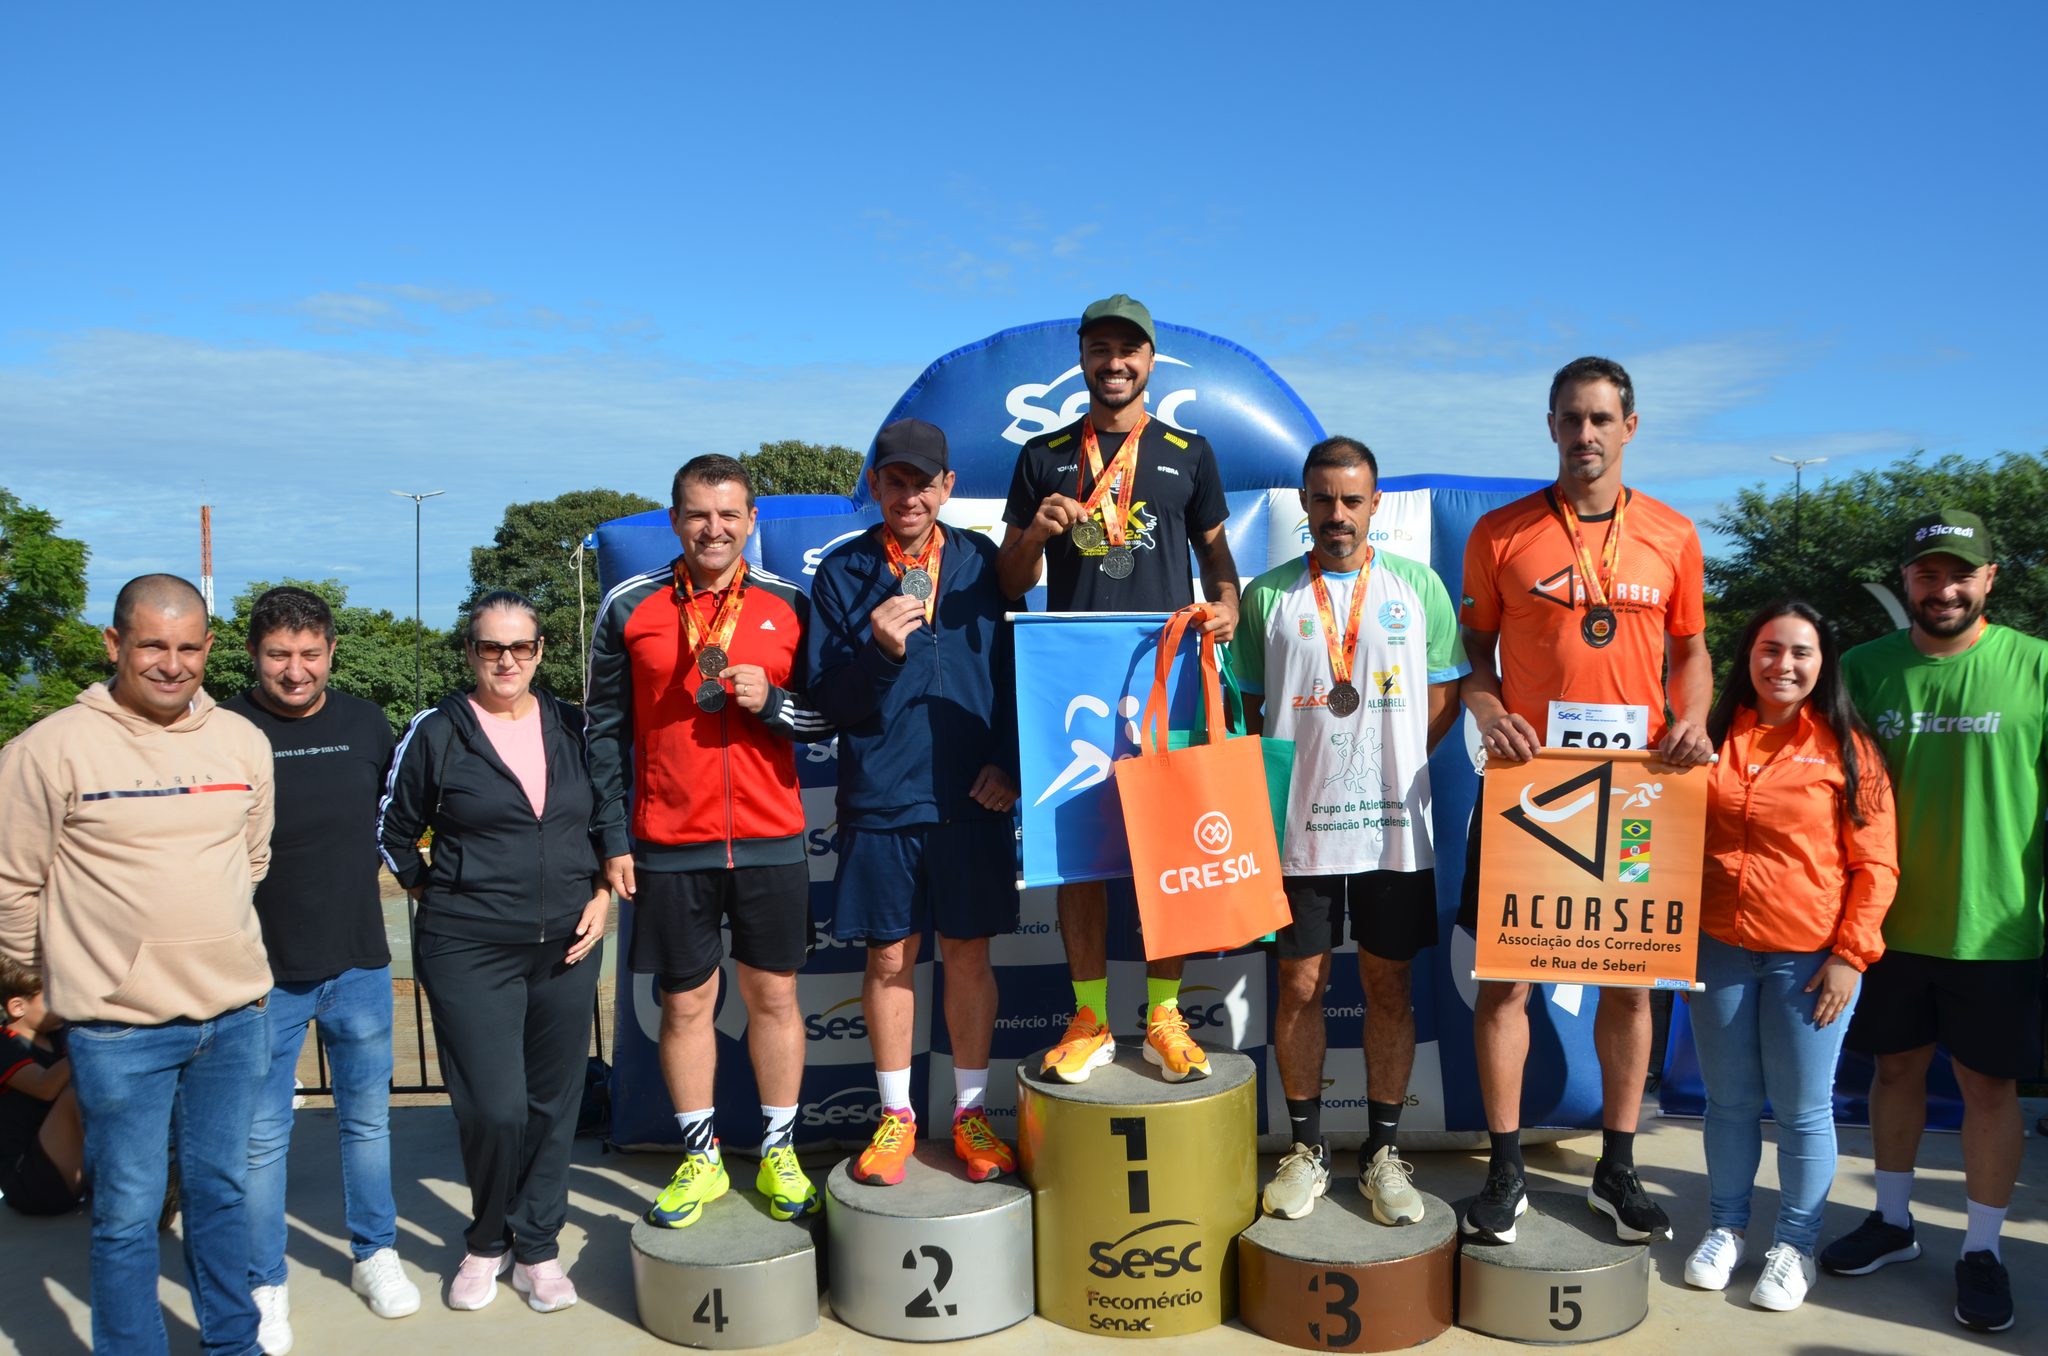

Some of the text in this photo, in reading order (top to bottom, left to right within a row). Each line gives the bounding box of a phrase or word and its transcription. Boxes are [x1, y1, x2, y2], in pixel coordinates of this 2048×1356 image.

[1001, 383, 1198, 446] Sec
[1928, 524, 1974, 538] Sicredi
[1575, 583, 1660, 605] ARSEB
[1909, 711, 2001, 734] Sicredi
[134, 774, 214, 788] PARIS
[1311, 799, 1403, 816] Grupo de Atletismo
[1305, 816, 1410, 833] Associação Portelense
[1159, 852, 1261, 895] CRESOL
[1501, 893, 1684, 935] ACORSEB
[1497, 932, 1682, 953] Associação dos Corredores
[1530, 955, 1646, 973] de Rua de Seberi
[805, 1014, 868, 1041] Ses
[994, 1014, 1048, 1029] mércio
[1110, 1117, 1150, 1214] 1
[1088, 1240, 1202, 1279] Sesc
[902, 1245, 958, 1319] 2
[692, 1288, 729, 1333] 4
[1088, 1287, 1203, 1311] Fecomércio
[1308, 1271, 1361, 1347] 3
[1549, 1285, 1582, 1331] 5
[1089, 1314, 1152, 1332] Senac
